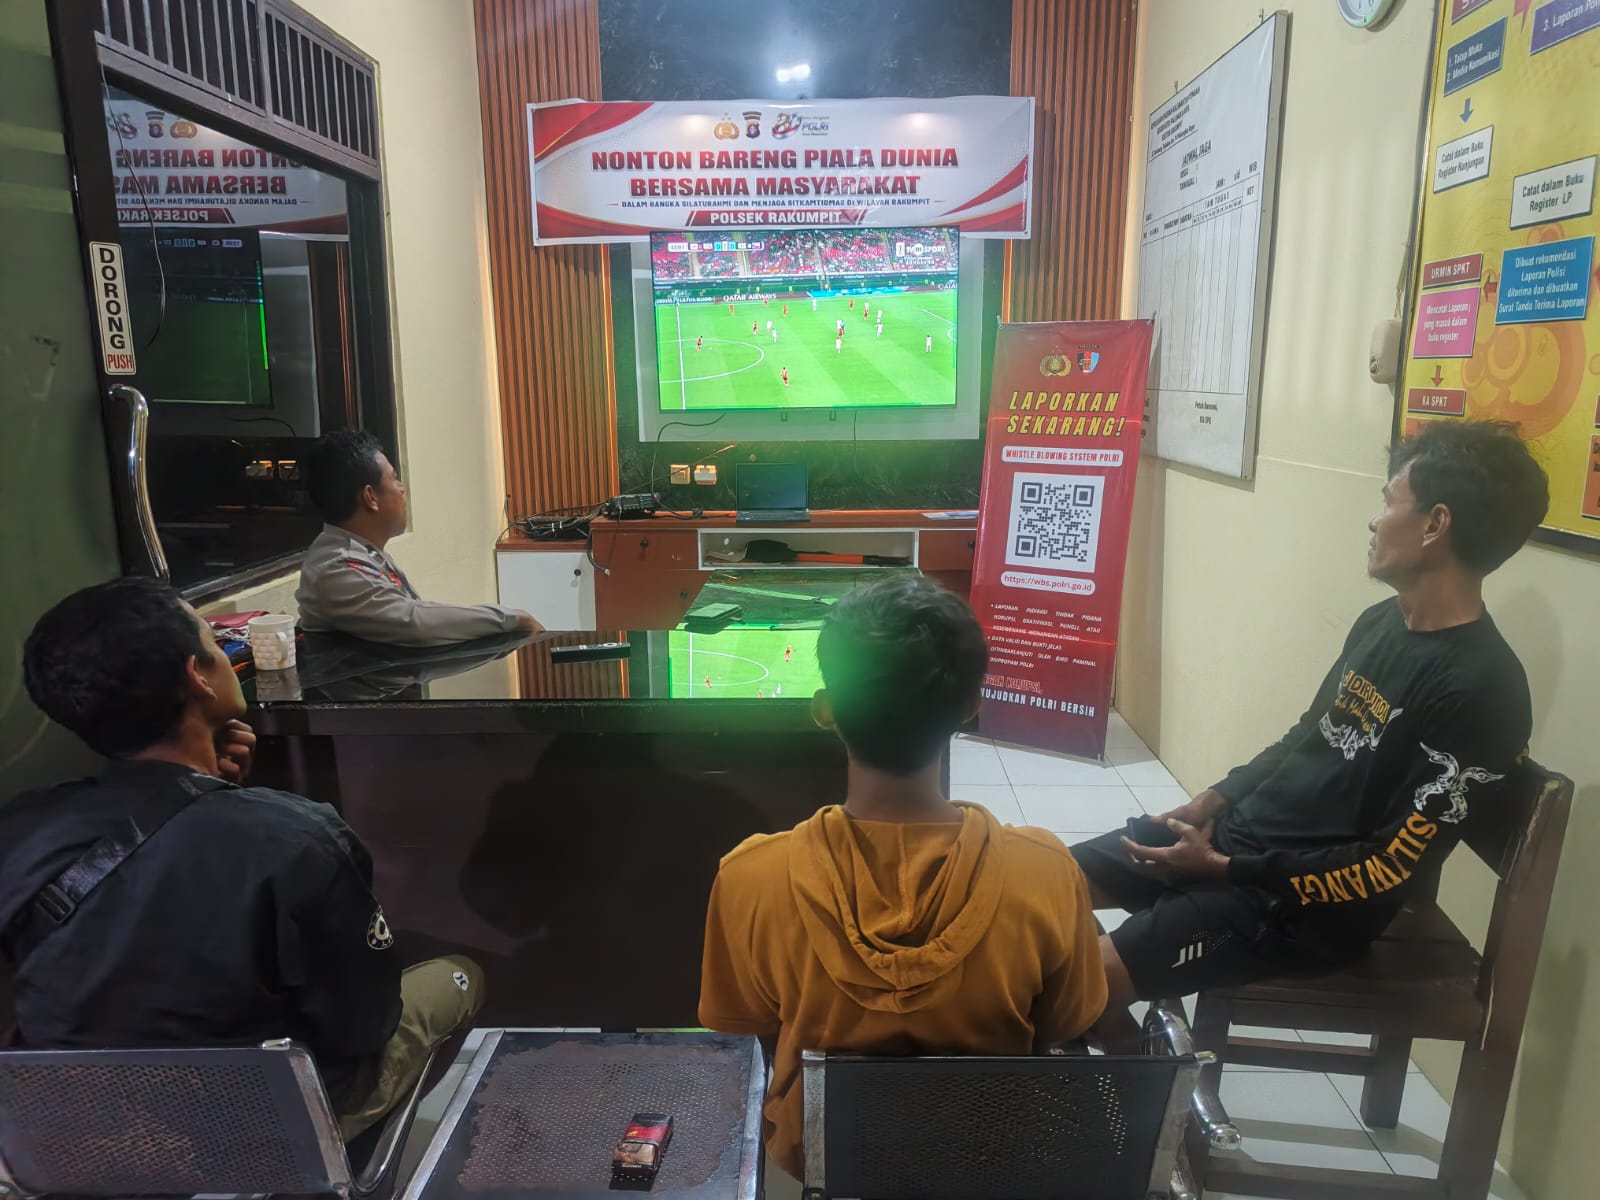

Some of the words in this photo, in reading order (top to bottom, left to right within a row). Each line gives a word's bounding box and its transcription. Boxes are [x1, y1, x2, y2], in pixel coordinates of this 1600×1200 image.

[1552, 5, 1584, 27] Laporan
[592, 151, 692, 170] NONTON
[699, 150, 797, 169] BARENG
[804, 148, 875, 168] PIALA
[881, 147, 959, 167] DUNIA
[630, 177, 750, 196] BERSAMA
[756, 175, 921, 196] MASYARAKAT
[1522, 183, 1540, 198] Catat
[1541, 179, 1564, 193] dalam
[1565, 173, 1585, 187] Buku
[892, 198, 930, 206] RAKUMPIT
[1529, 196, 1559, 213] Register
[1562, 191, 1573, 205] LP
[710, 212, 764, 224] POLSEK
[768, 211, 842, 224] RAKUMPIT
[1515, 255, 1535, 268] Dibuat
[1535, 248, 1577, 265] rekomendasi
[1453, 262, 1471, 276] SPKT
[1521, 269, 1546, 283] Laporan
[1547, 266, 1566, 279] Polisi
[99, 247, 126, 350] DORONG
[723, 294, 747, 302] QATAR
[1507, 286, 1532, 298] diterima
[1533, 284, 1545, 295] dan
[1545, 281, 1578, 294] dibuatkan
[1499, 302, 1515, 313] Surat
[1515, 300, 1533, 312] Tanda
[1534, 299, 1556, 311] Terima
[1556, 297, 1586, 311] Laporan
[107, 354, 133, 369] PUSH
[1008, 391, 1120, 412] LAPORKAN
[1431, 395, 1448, 407] SPKT
[1007, 414, 1127, 437] SEKARANG!
[1006, 450, 1035, 459] WHISTLE
[1037, 451, 1067, 460] BLOWING
[1069, 452, 1097, 462] SYSTEM
[1100, 453, 1120, 462] POLRI
[1004, 575, 1092, 592] https://wbs.polri.go.id
[1030, 696, 1058, 710] POLRI
[1060, 701, 1096, 718] BERSIH
[1289, 811, 1438, 906] SILIWANGI
